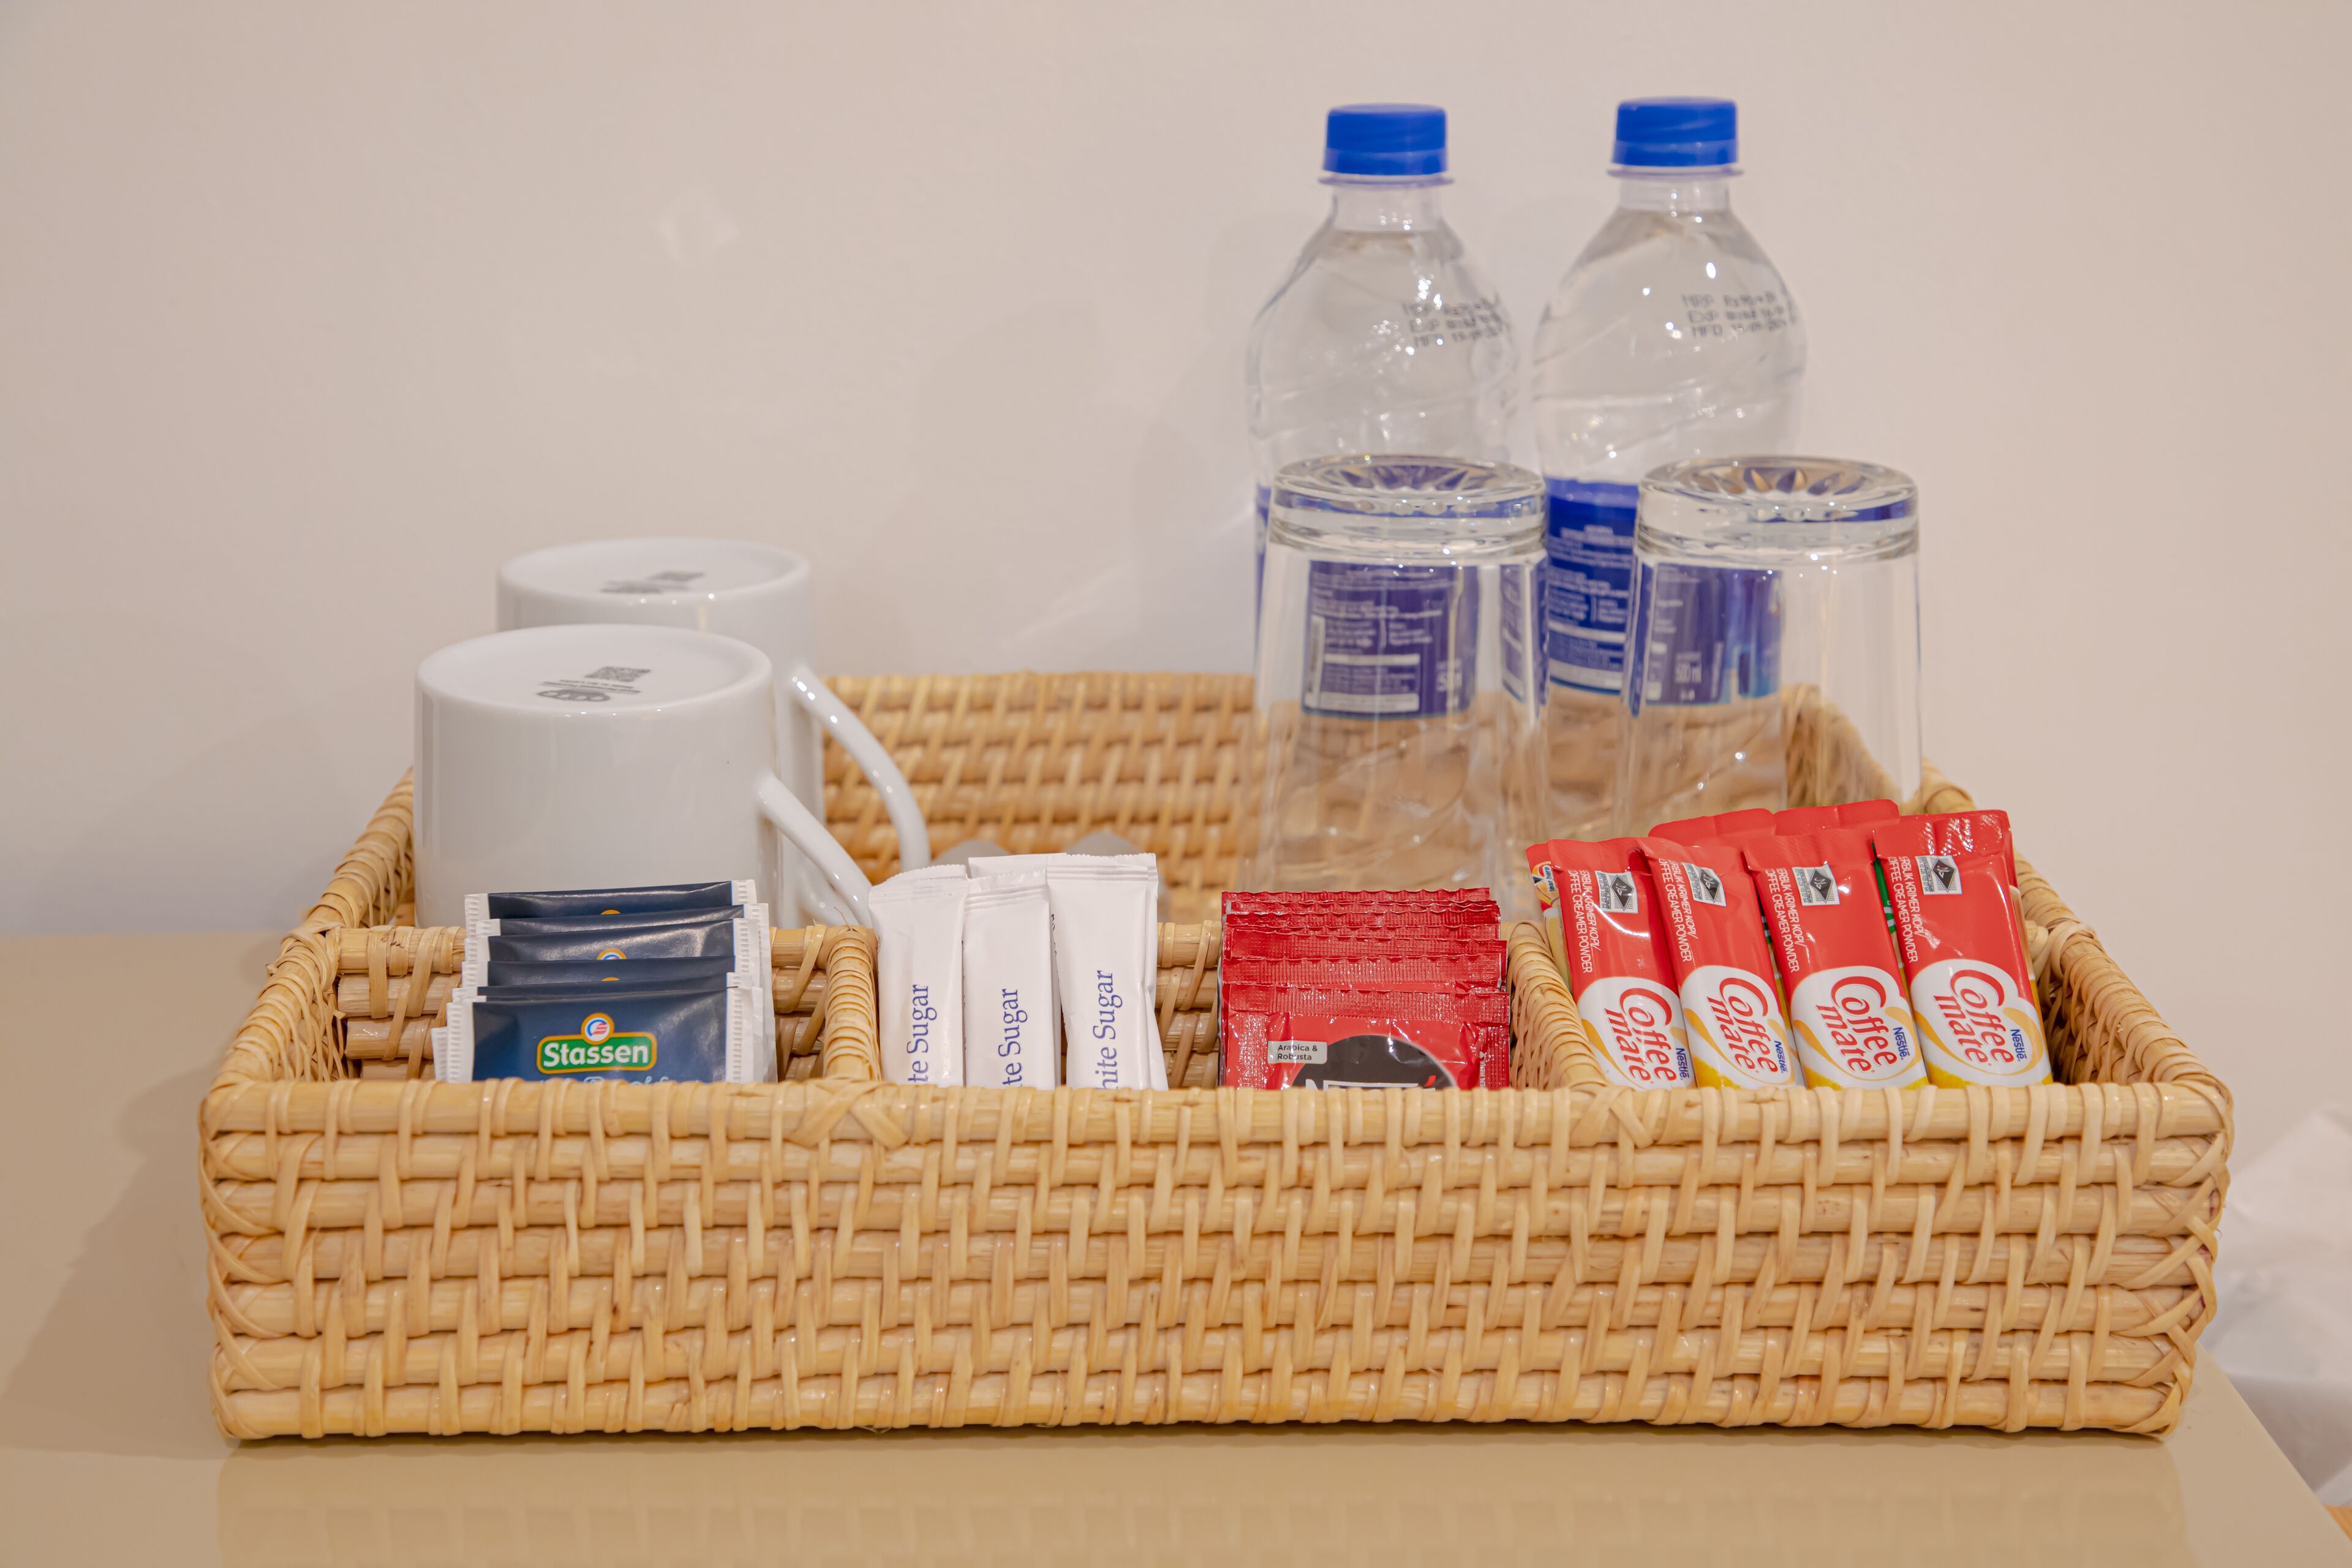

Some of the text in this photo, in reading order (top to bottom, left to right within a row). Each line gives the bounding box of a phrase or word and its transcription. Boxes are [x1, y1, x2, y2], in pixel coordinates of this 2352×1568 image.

[1572, 894, 1587, 934] CREAMER
[1585, 895, 1597, 928] KRIMER
[1665, 884, 1683, 924] CREAMER
[1675, 923, 1692, 962] POWDER
[1677, 884, 1692, 916] KRIMER
[1784, 891, 1800, 923] KRIMER
[1893, 883, 1910, 924] CREAMER
[1902, 923, 1918, 963] POWDER
[1905, 881, 1920, 913] KRIMER
[1578, 935, 1593, 974] POWDER
[1772, 894, 1790, 934] CREAMER
[1782, 933, 1800, 973] POWDER
[907, 984, 938, 1054] Sugar
[998, 989, 1028, 1057] Sugar
[1093, 970, 1123, 1039] Sugar
[1619, 987, 1677, 1082] Coffee
[1706, 996, 1756, 1069] mate
[1719, 977, 1779, 1072] Coffee
[1816, 1005, 1872, 1072] mate
[1831, 976, 1898, 1065] Coffee
[1934, 995, 1989, 1063] mate
[1950, 969, 2015, 1063] Coffee
[543, 1042, 648, 1068] Stassen
[1605, 1008, 1651, 1082] mate
